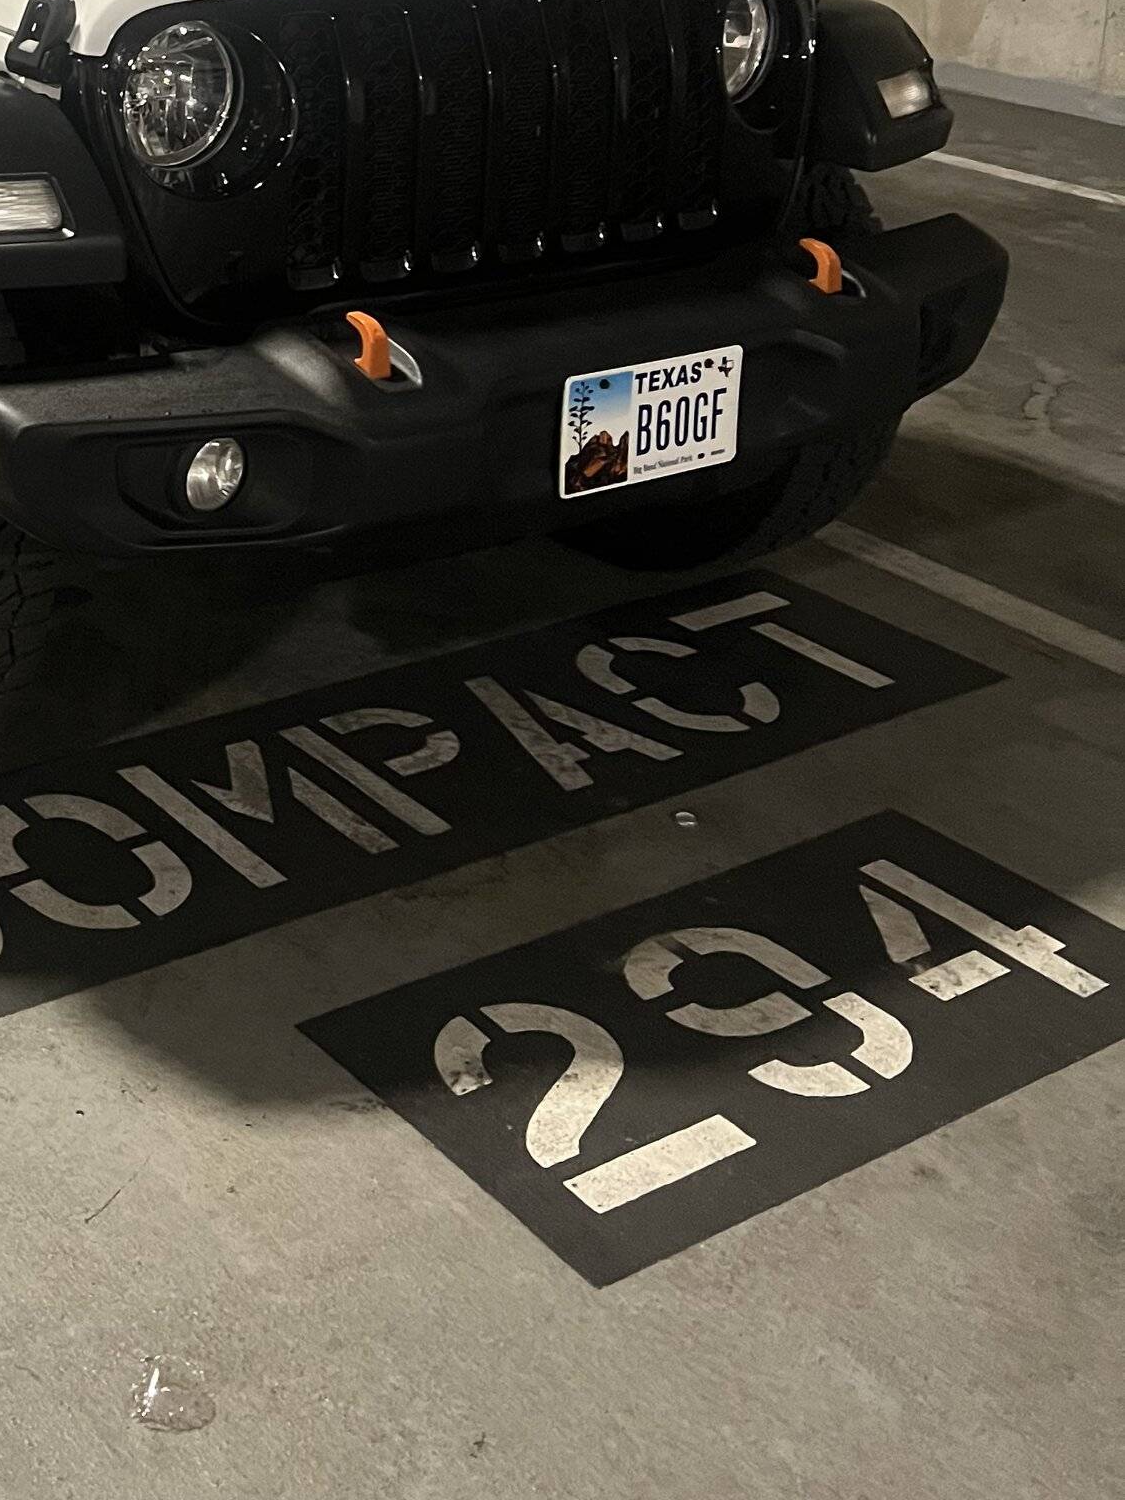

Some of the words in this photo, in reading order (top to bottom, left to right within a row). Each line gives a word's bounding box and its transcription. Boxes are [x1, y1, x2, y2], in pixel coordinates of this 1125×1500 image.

[634, 361, 703, 395] TEXAS
[635, 387, 728, 457] B60GF
[433, 859, 1110, 1215] 294
